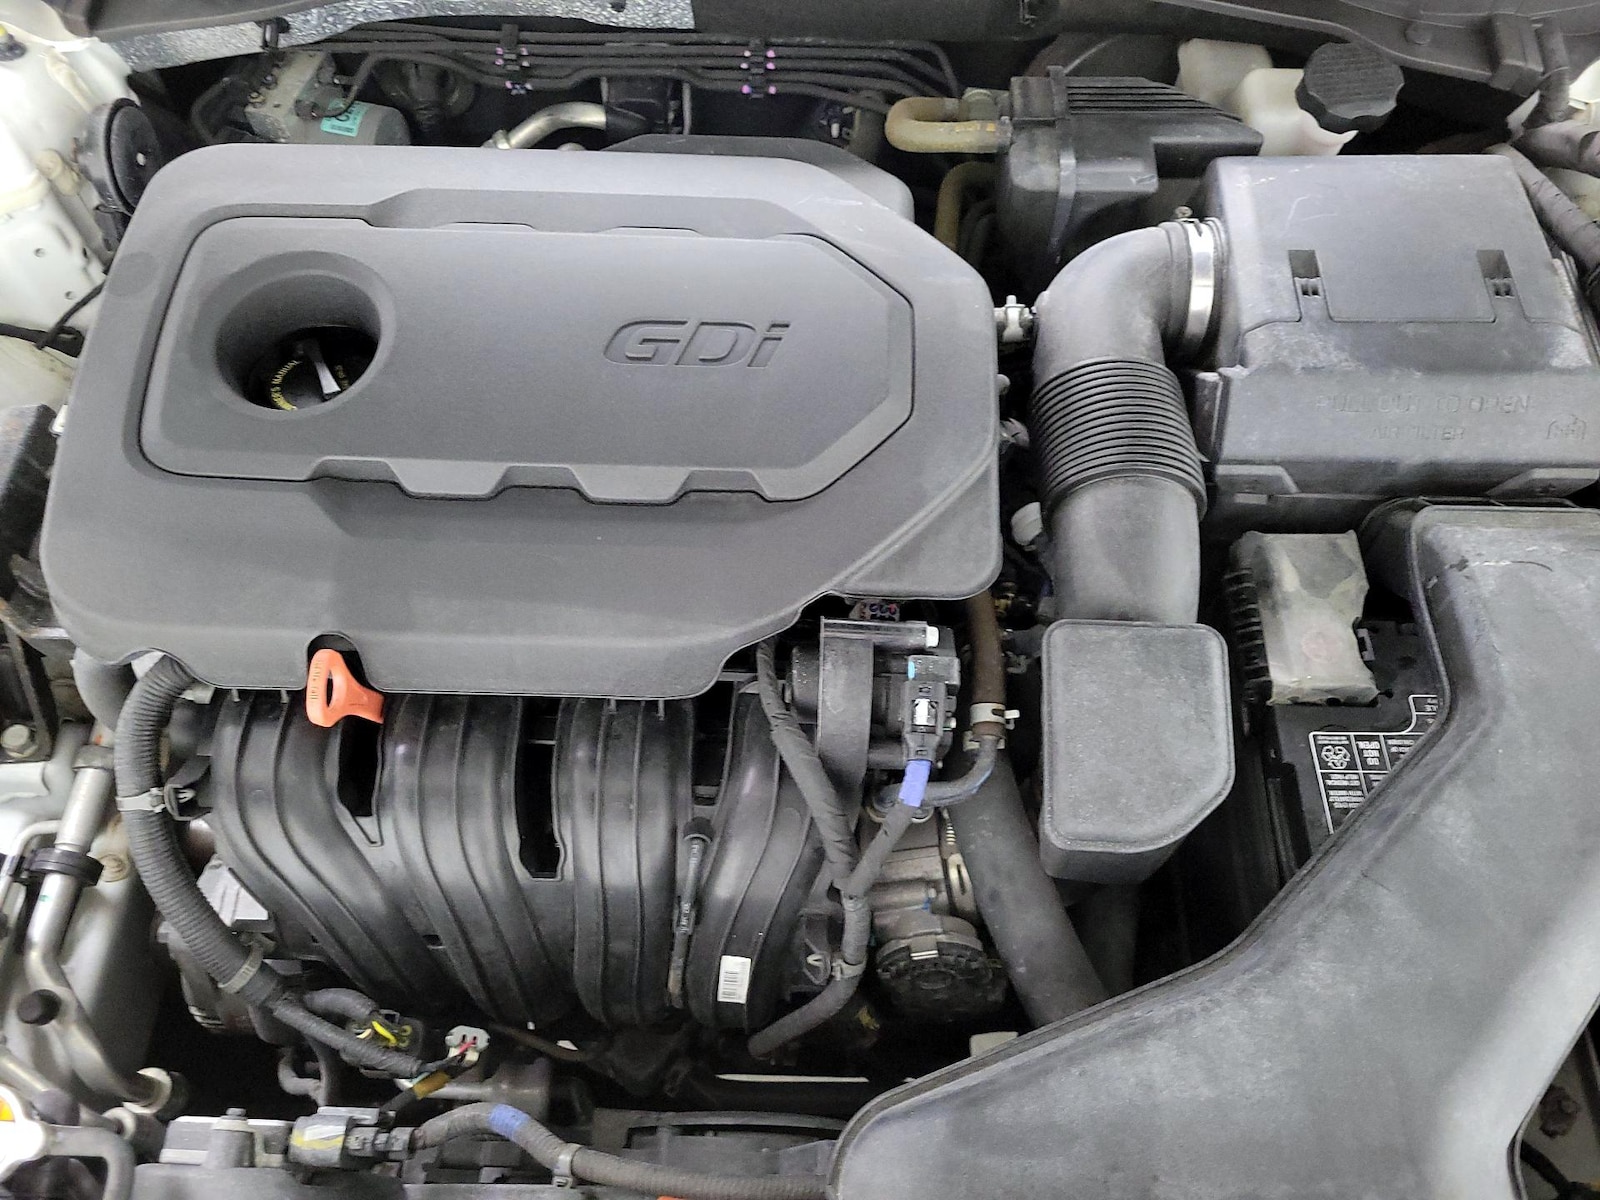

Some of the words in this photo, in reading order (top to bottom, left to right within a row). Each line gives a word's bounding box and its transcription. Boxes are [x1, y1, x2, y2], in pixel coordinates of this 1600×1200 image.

[602, 319, 791, 368] GDi
[1315, 394, 1372, 413] PULL
[1378, 394, 1421, 413] OUT
[1436, 394, 1463, 412] TO
[1468, 394, 1531, 413] OPEN
[1368, 425, 1400, 440] AIR
[1407, 425, 1466, 440] FILTER
